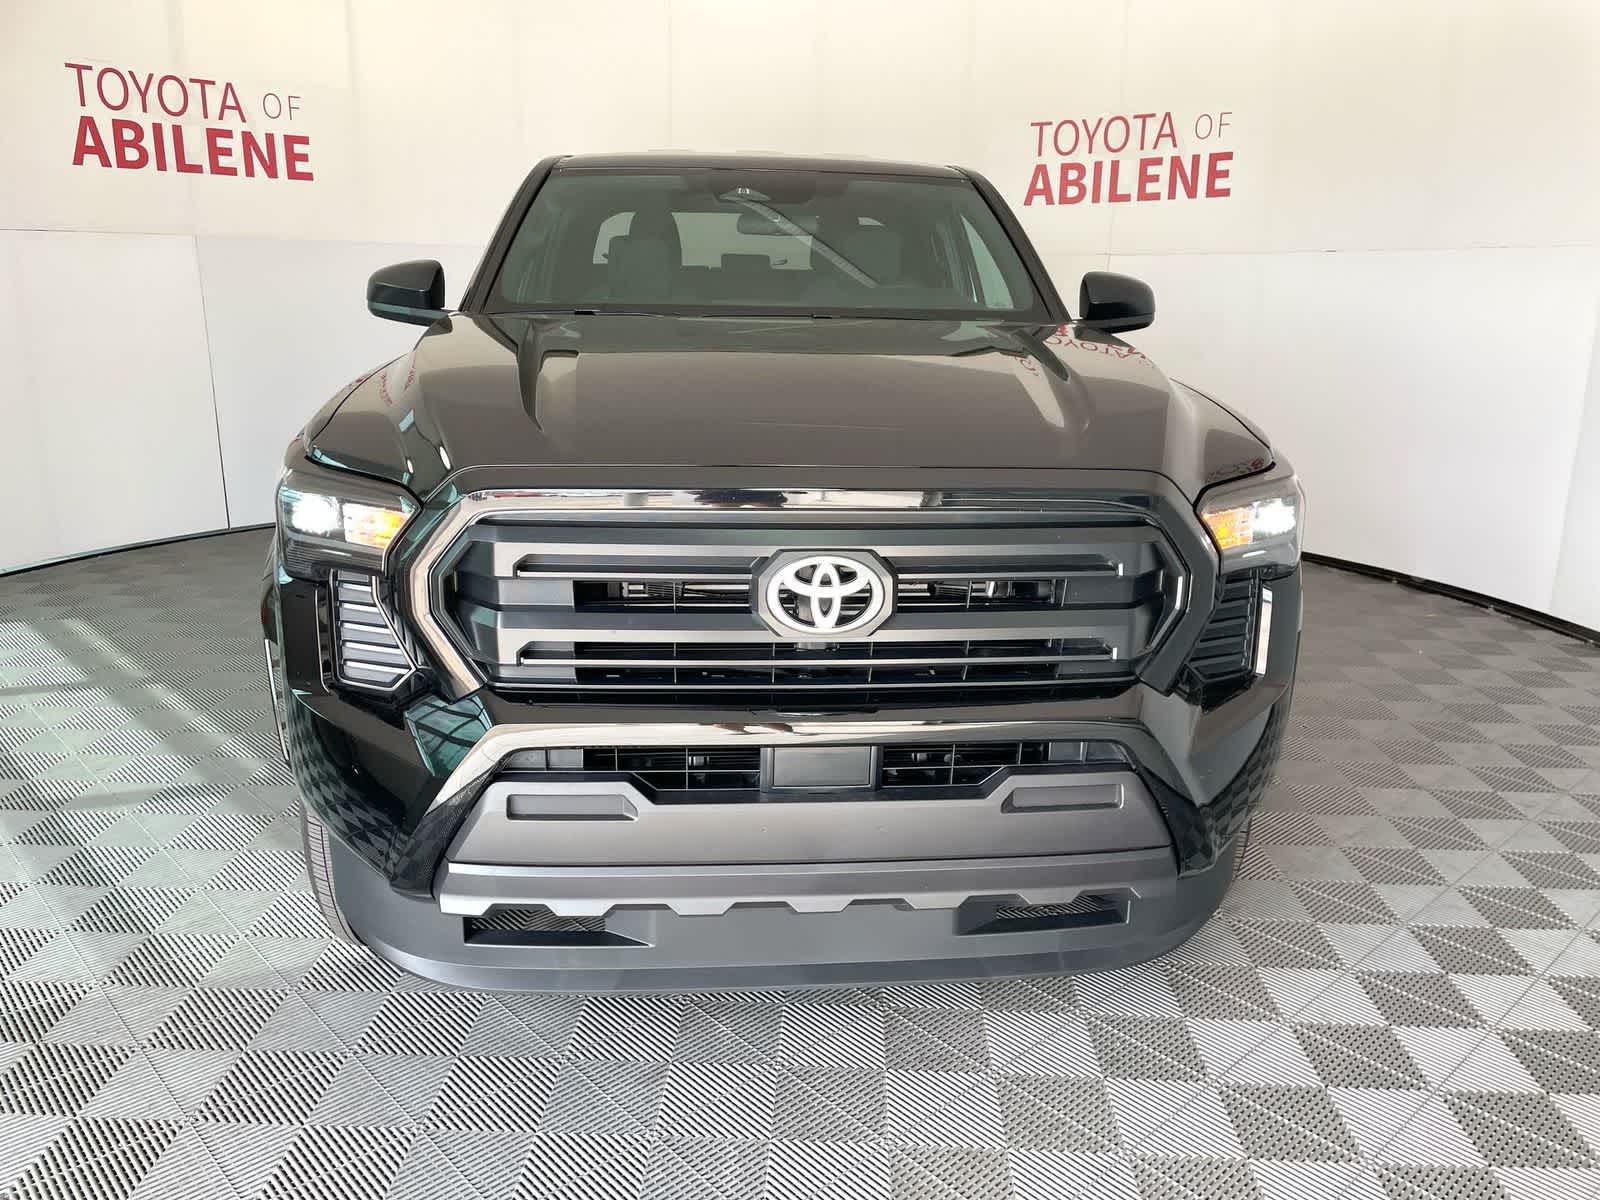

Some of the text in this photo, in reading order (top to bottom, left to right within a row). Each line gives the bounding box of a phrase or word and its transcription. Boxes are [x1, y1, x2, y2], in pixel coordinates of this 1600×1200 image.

[64, 62, 302, 123] TOYOTA OF
[72, 115, 314, 182] ABILENE
[1030, 111, 1233, 157] TOYOTA OF
[1023, 151, 1234, 207] ABILENE
